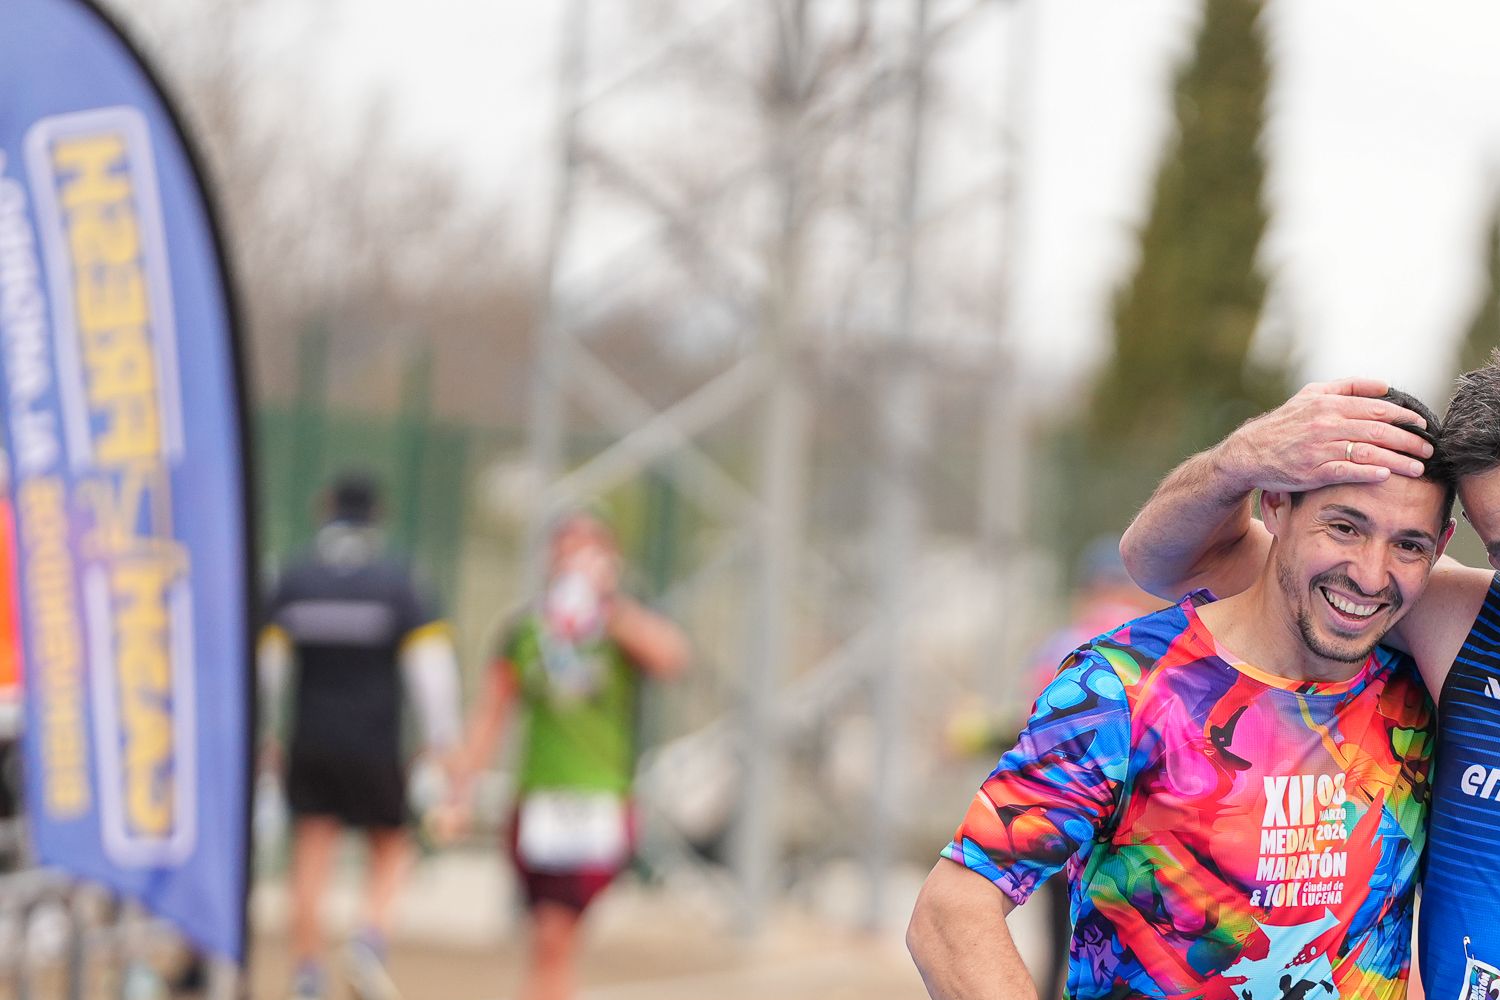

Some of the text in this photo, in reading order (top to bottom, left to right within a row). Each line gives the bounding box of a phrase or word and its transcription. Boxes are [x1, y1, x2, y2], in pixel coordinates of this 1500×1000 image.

[1262, 775, 1315, 827] XII
[1317, 773, 1347, 807] 08
[1260, 827, 1315, 854] MEDIA
[1316, 823, 1347, 841] 2026
[1256, 847, 1347, 881] MARATÓN
[1264, 883, 1301, 907] 10K
[1302, 891, 1342, 906] LUCENA
[1303, 881, 1344, 893] Ciudad de
